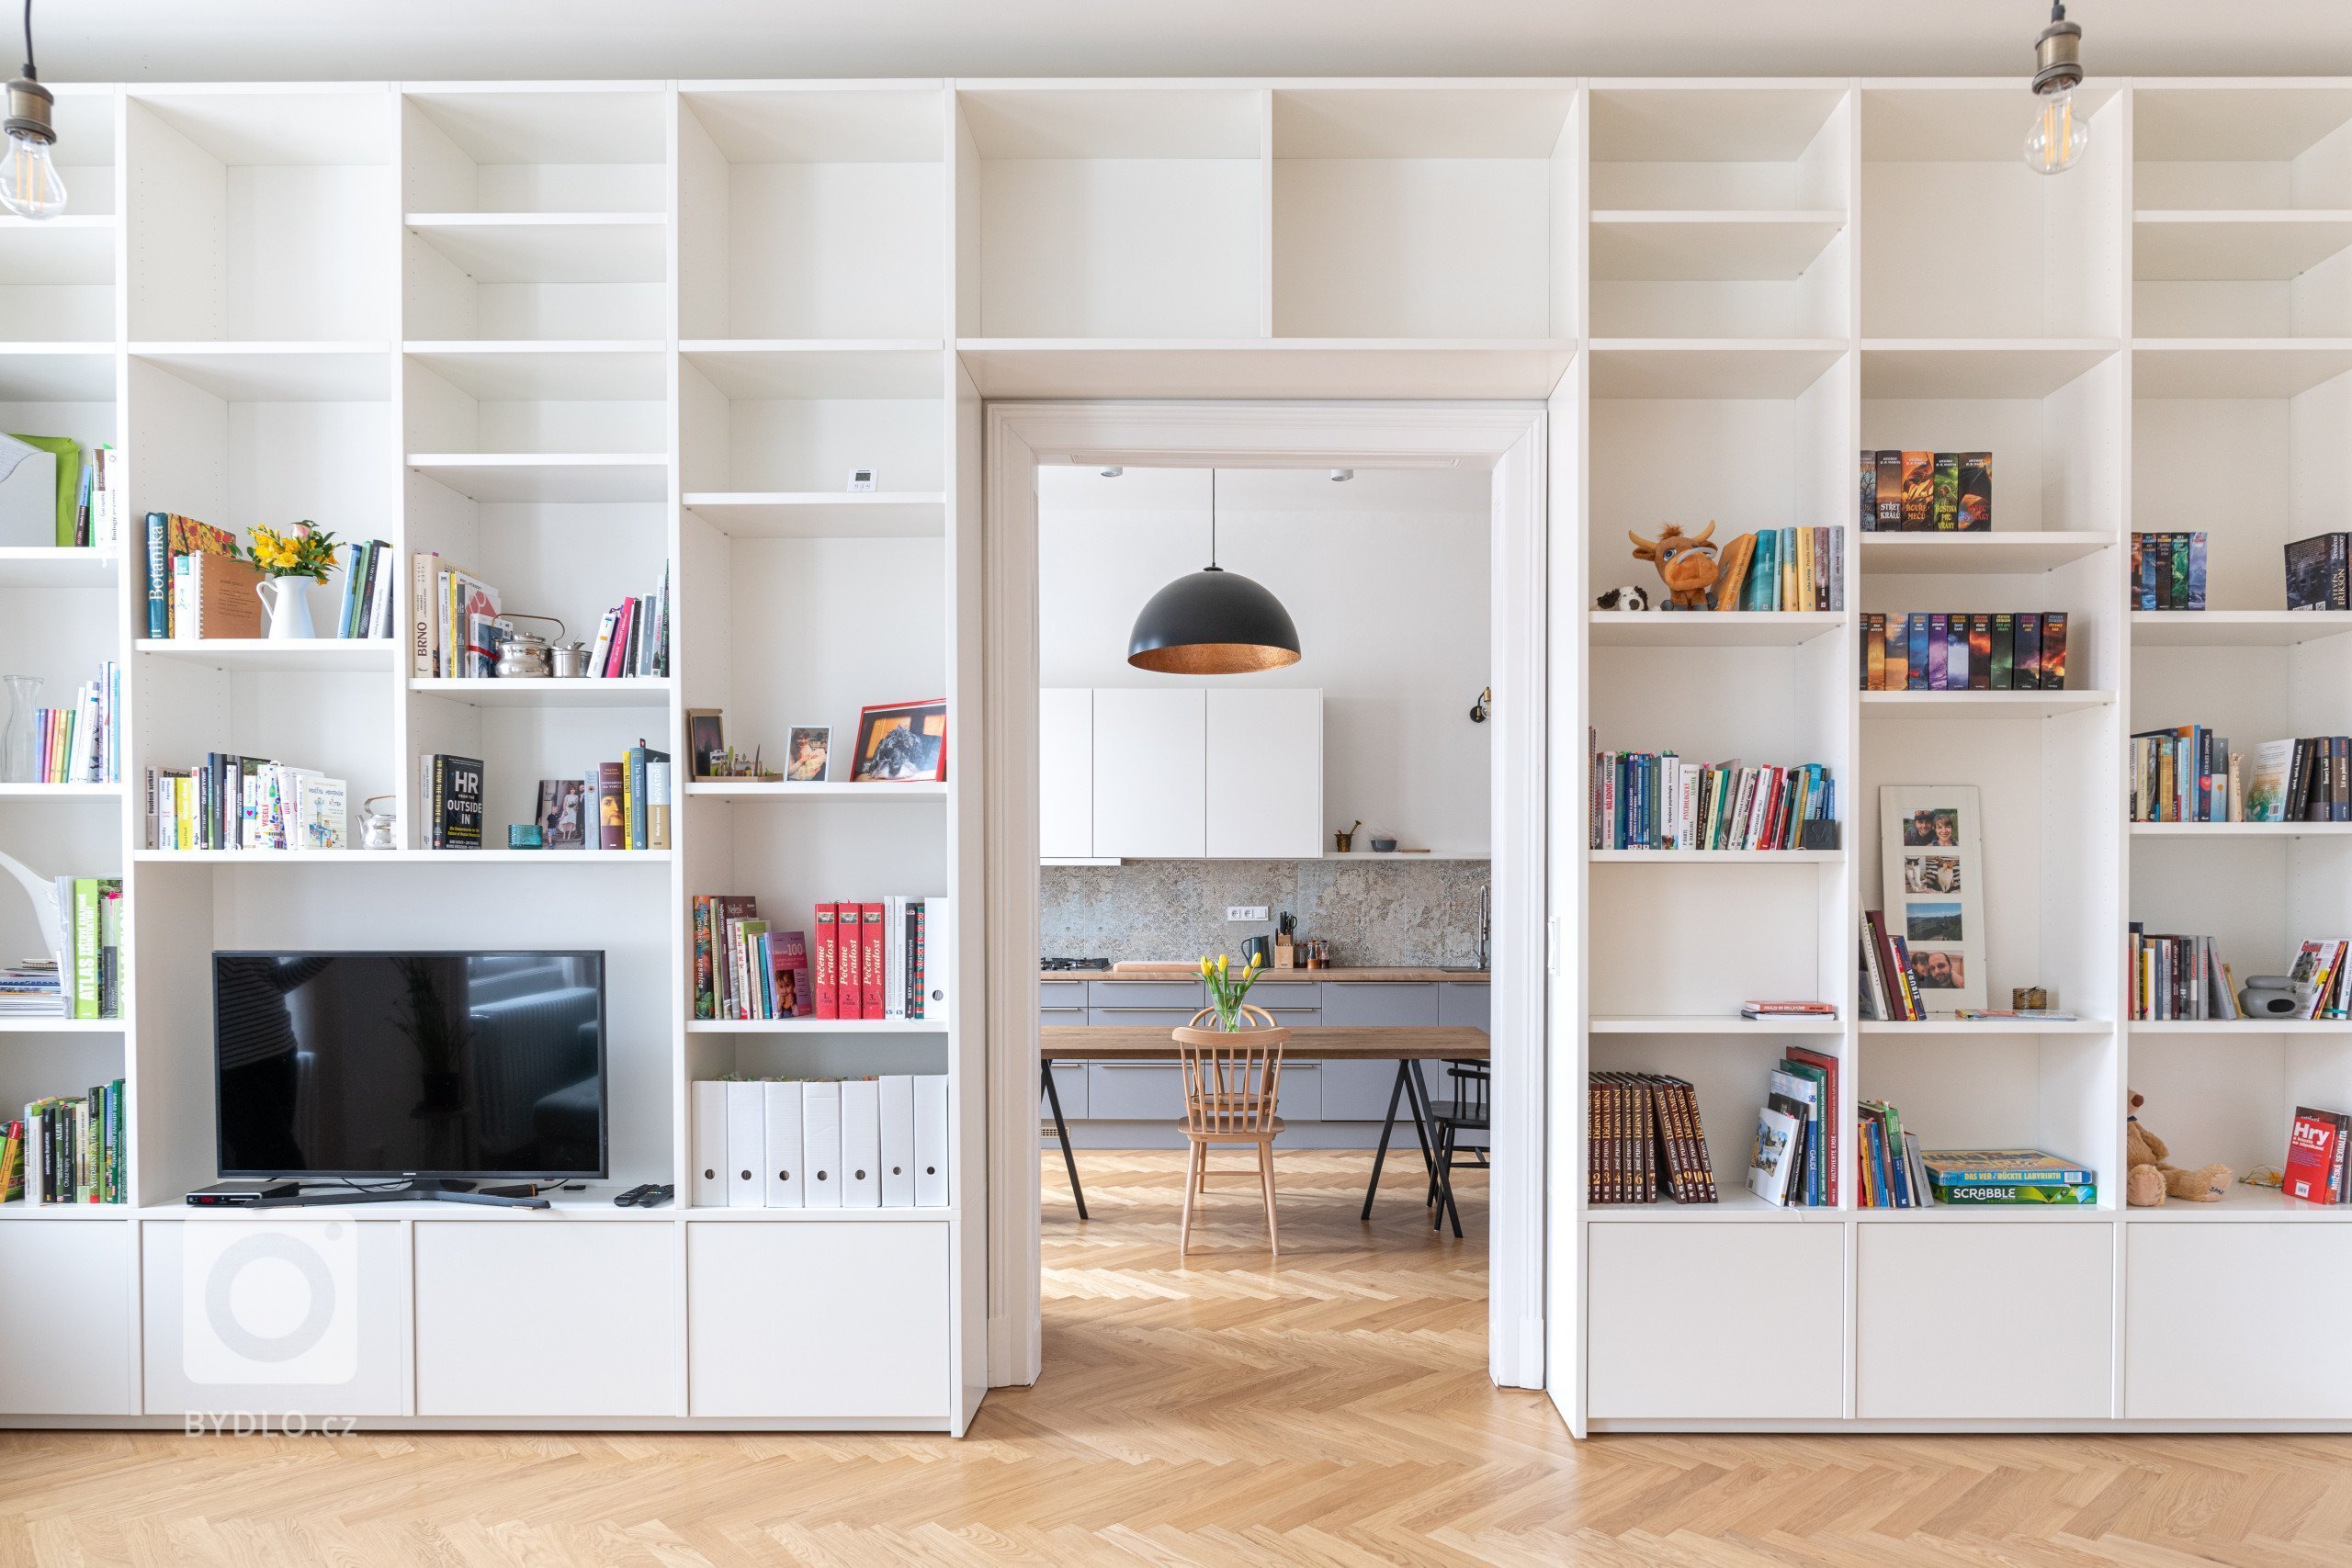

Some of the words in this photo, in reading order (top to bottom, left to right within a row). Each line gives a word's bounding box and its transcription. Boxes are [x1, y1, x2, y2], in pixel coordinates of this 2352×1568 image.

[1880, 502, 1901, 512] STŘET
[1880, 511, 1901, 520] KRÁLŮ
[1905, 502, 1927, 512] BOUŘE
[1907, 512, 1926, 520] MEČŮ
[1935, 504, 1957, 513] HOSTINA
[1941, 513, 1952, 521] PRO
[1938, 521, 1954, 529] VRÁNY
[148, 525, 164, 601] Botanika
[2337, 568, 2346, 605] ERIKSON
[417, 622, 427, 656] BRNO
[436, 760, 443, 768] HR
[455, 770, 479, 794] HR
[652, 765, 662, 804] NOVÁTOŘI
[447, 799, 482, 814] OUTSIDE
[1682, 783, 1690, 820] PSYCHOLOGICKÝ
[461, 813, 470, 825] IN
[77, 927, 87, 956] SVĚTOVÉ
[786, 942, 803, 956] 100
[817, 946, 826, 986] Pečeme
[826, 939, 834, 974] radost
[840, 946, 848, 986] Pečeme
[849, 939, 857, 974] radost
[863, 946, 872, 986] Pečeme
[872, 939, 880, 974] radost
[915, 945, 924, 971] VÁNOCE
[78, 958, 95, 1001] ATLAS
[1906, 968, 1920, 1000] ZIBURA
[1657, 1090, 1668, 1114] UMĚNÍ
[1667, 1089, 1678, 1111] UMĚNÍ
[1677, 1089, 1688, 1112] UMĚNÍ
[1689, 1090, 1699, 1114] UMĚNÍ
[87, 1116, 97, 1152] ZAHRADY
[1592, 1113, 1600, 1139] DĚJINY
[1601, 1113, 1610, 1139] DĚJINY
[1623, 1112, 1632, 1139] DĚJINY
[1634, 1113, 1642, 1139] DĚJINY
[1662, 1114, 1674, 1140] DĚJINY
[1672, 1112, 1683, 1138] DĚJINY
[1682, 1113, 1693, 1139] DĚJINY
[1693, 1114, 1704, 1140] DĚJINY
[2293, 1121, 2331, 1146] Hry
[2299, 1141, 2325, 1152] zápalkami
[2335, 1129, 2348, 1163] SEXUALITA
[62, 1157, 71, 1172] krajiny
[88, 1153, 98, 1189] MODERNÍ
[1963, 1172, 1978, 1180] DAS
[1978, 1172, 1992, 1180] VER
[1996, 1171, 2023, 1180] RÜCKTE
[2023, 1171, 2062, 1180] LABYRINTH
[1593, 1173, 1600, 1185] 2
[1603, 1172, 1610, 1184] 3
[1614, 1172, 1621, 1184] 4
[1626, 1173, 1632, 1185] 5
[1634, 1173, 1643, 1185] 6
[1649, 1173, 1656, 1185] 7
[1675, 1173, 1683, 1186] 8
[1683, 1171, 1691, 1183] 9
[1693, 1171, 1703, 1183] 10
[1704, 1172, 1714, 1184] 11
[2331, 1164, 2342, 1191] MUŽSKÁ
[1953, 1187, 2017, 1200] SCRABBLE
